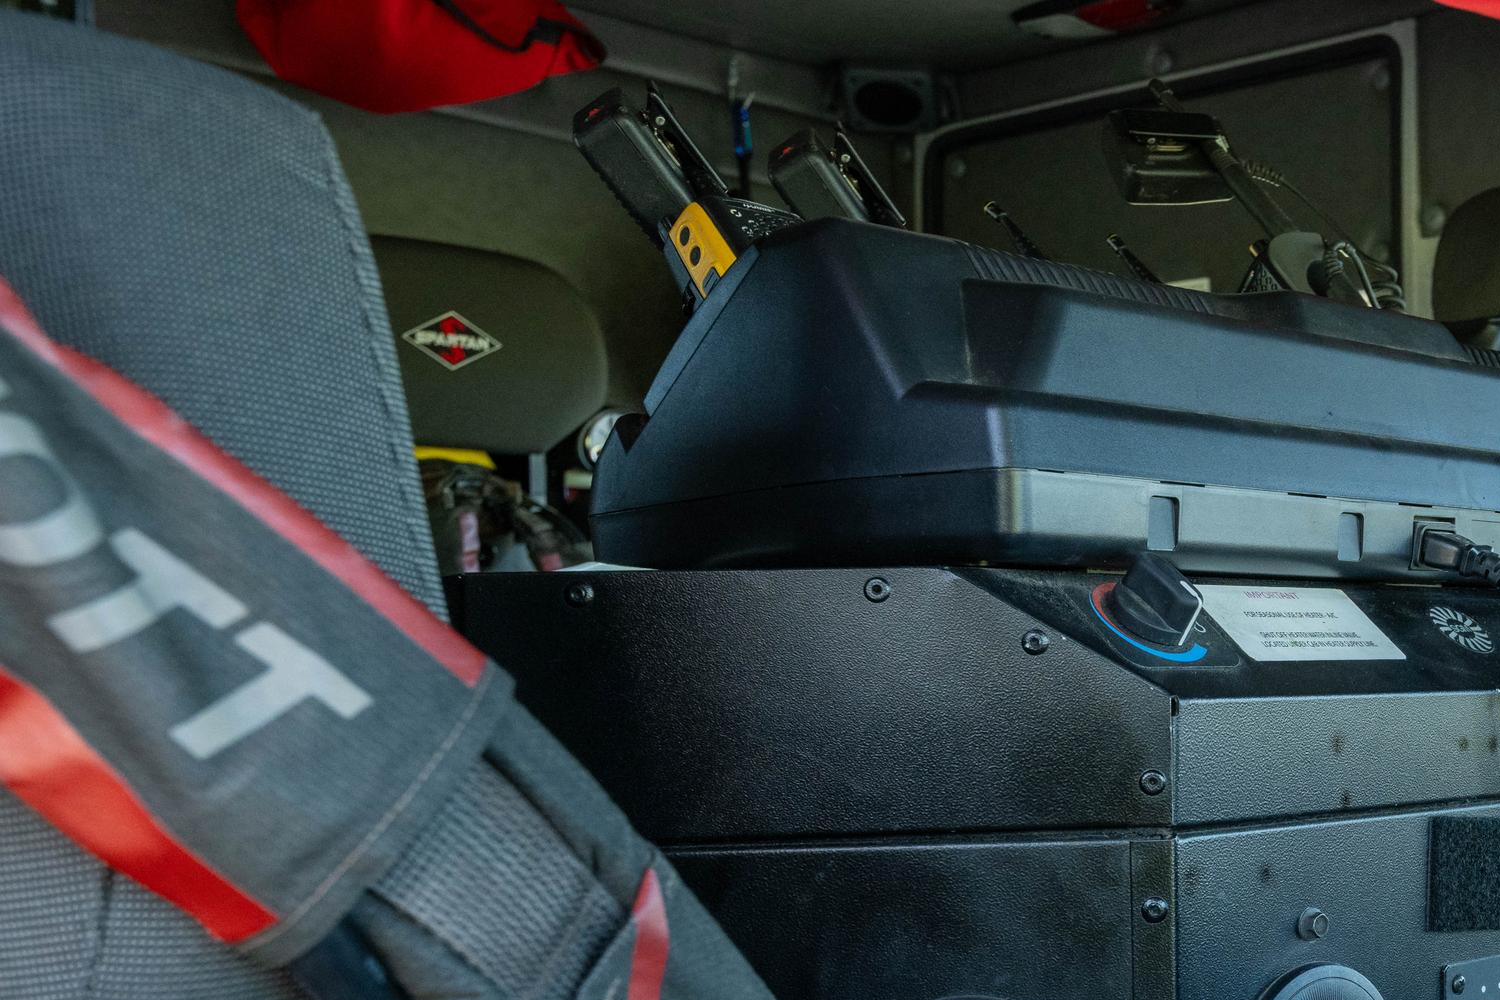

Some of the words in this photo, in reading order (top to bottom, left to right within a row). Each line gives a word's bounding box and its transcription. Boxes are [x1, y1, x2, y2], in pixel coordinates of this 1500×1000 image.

[415, 329, 490, 352] SPARTAN
[0, 374, 375, 761] OTT
[1242, 591, 1302, 599] IMPORTANT
